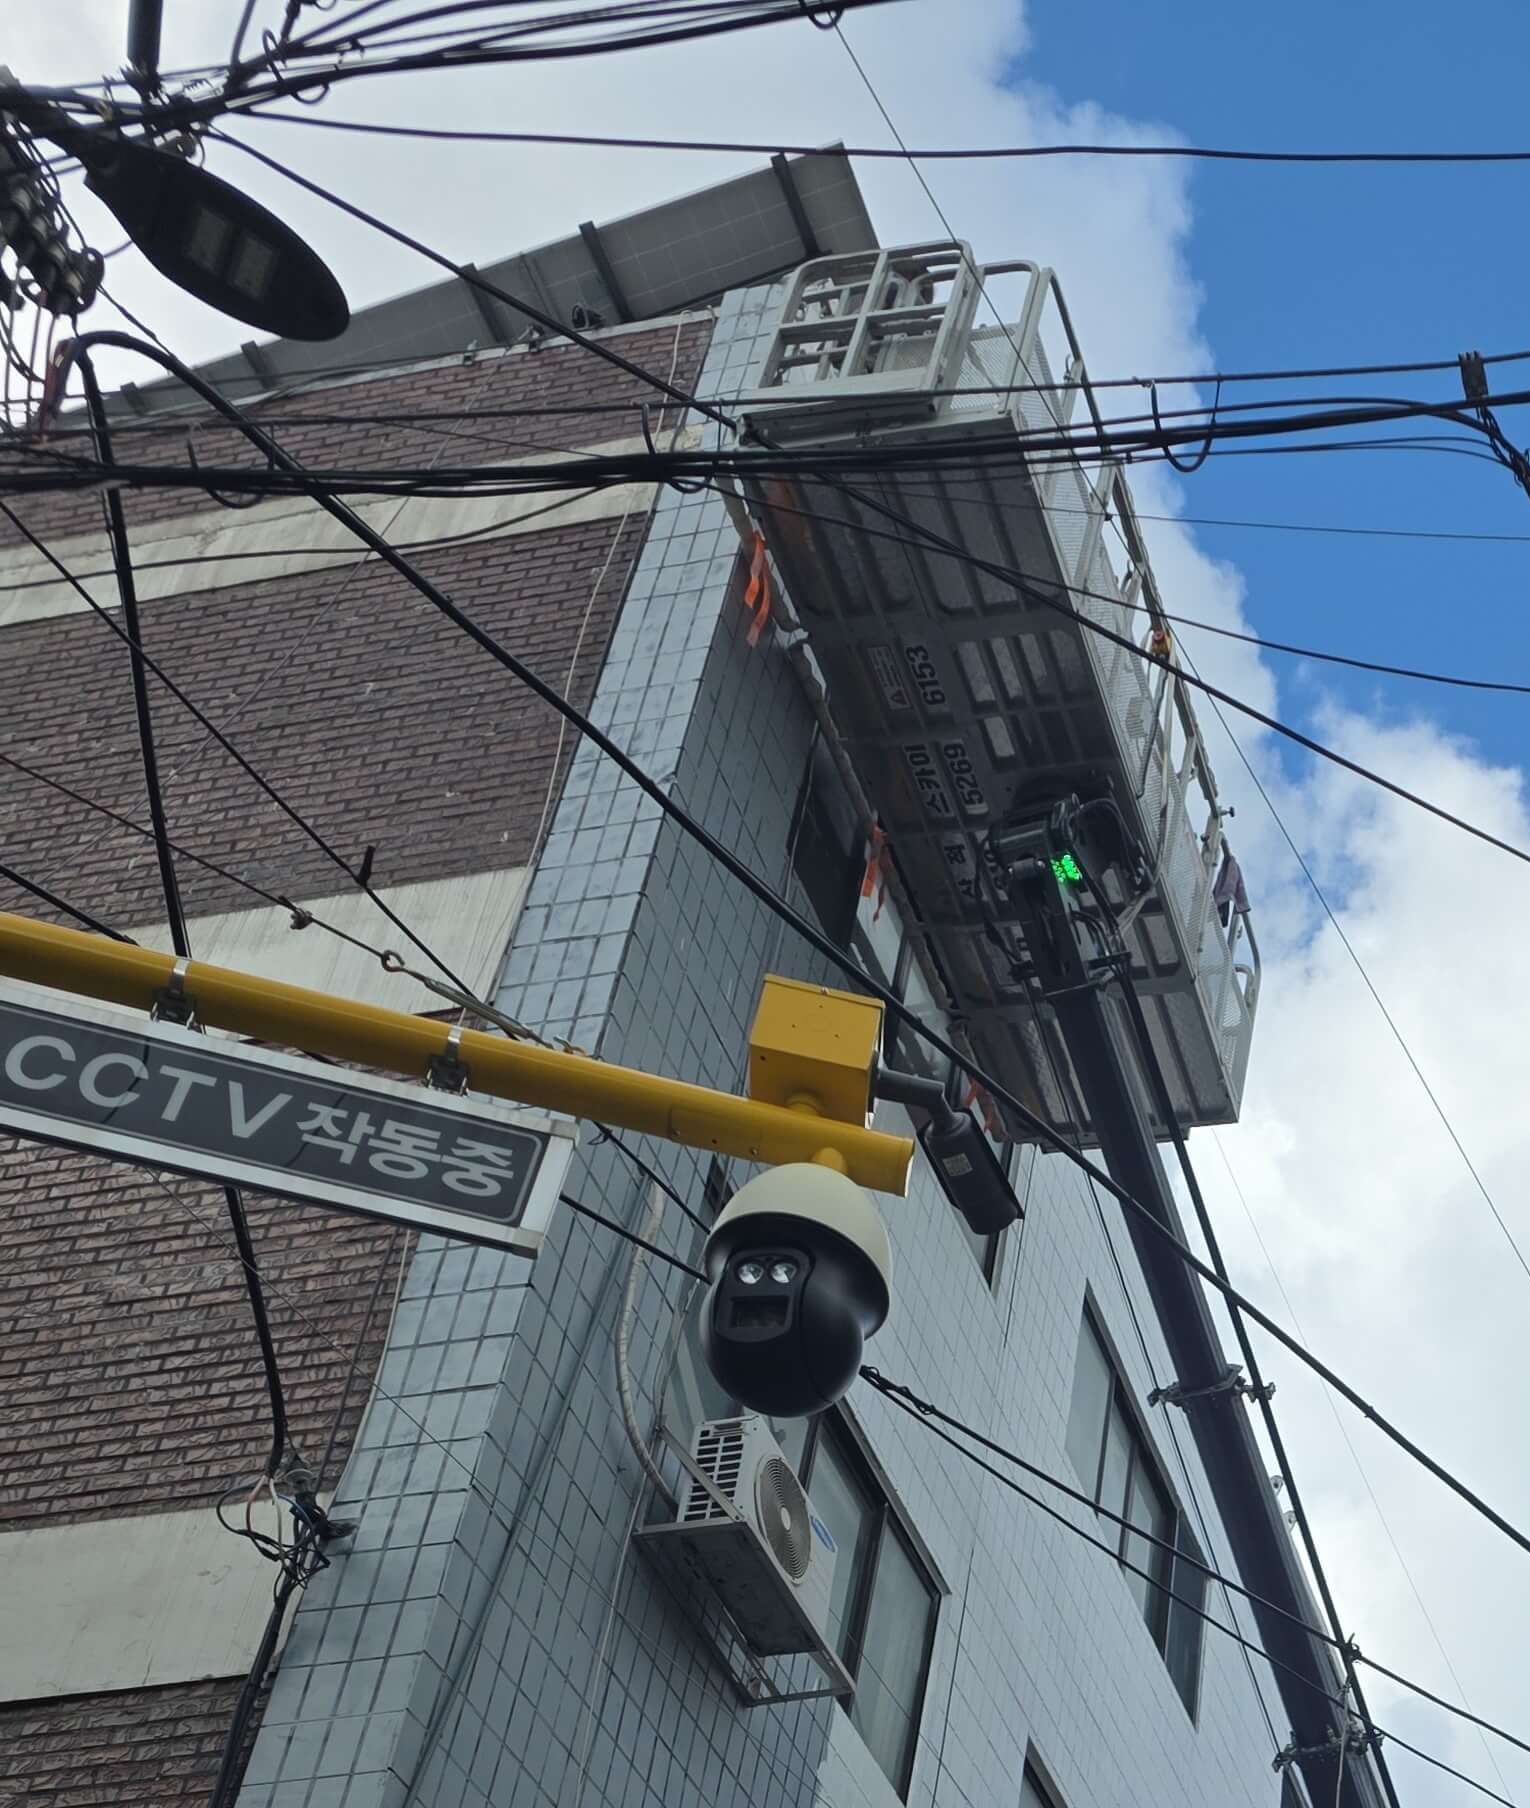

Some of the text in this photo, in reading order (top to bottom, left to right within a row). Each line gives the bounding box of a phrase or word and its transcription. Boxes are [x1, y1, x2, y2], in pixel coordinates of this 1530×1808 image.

[906, 645, 947, 706] 6153
[904, 744, 951, 816] 스카이
[944, 743, 984, 806] 5269
[4, 1035, 514, 1198] CCTV 작동중
